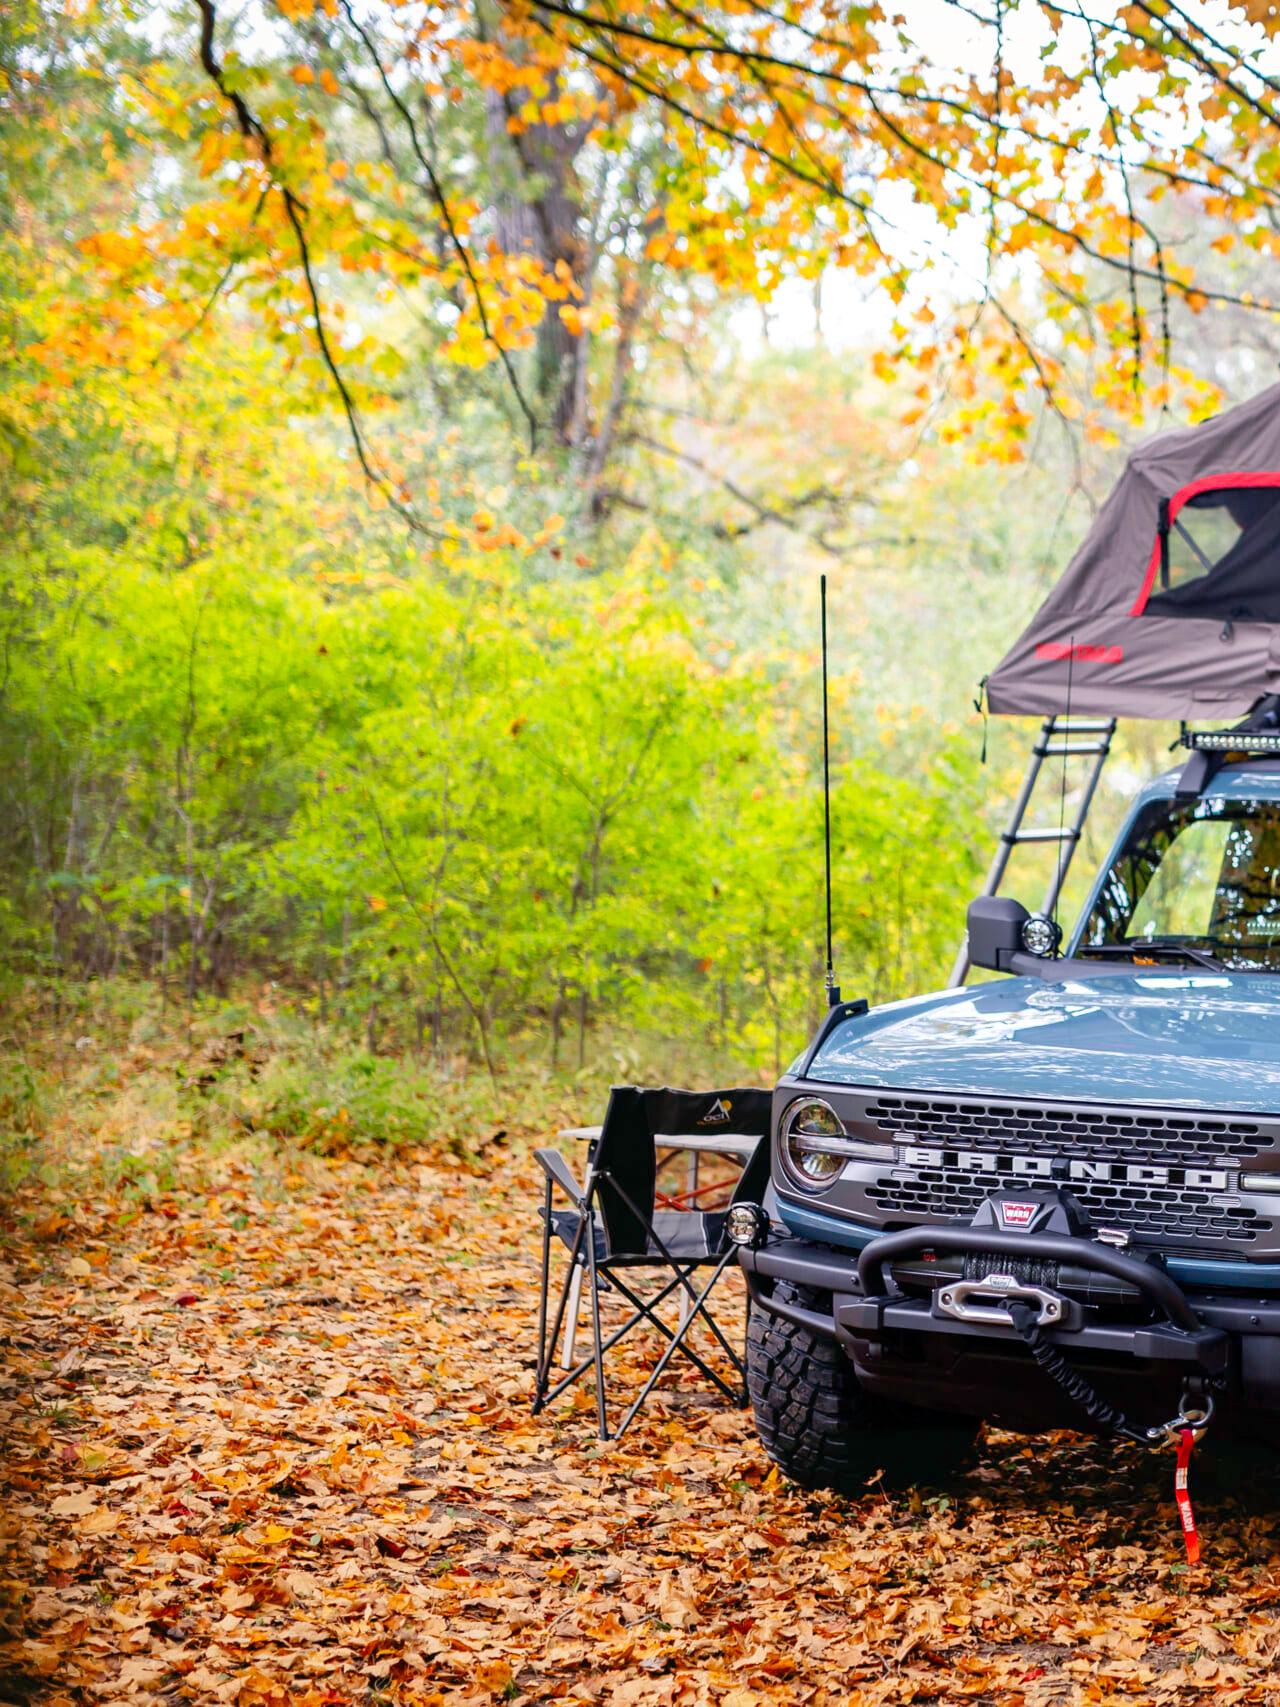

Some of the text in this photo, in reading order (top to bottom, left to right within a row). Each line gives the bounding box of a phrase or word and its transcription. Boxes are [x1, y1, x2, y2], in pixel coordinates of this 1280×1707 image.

[905, 1147, 1226, 1188] BRONCO
[1006, 1209, 1030, 1219] WARN
[1180, 1500, 1195, 1532] WARN
